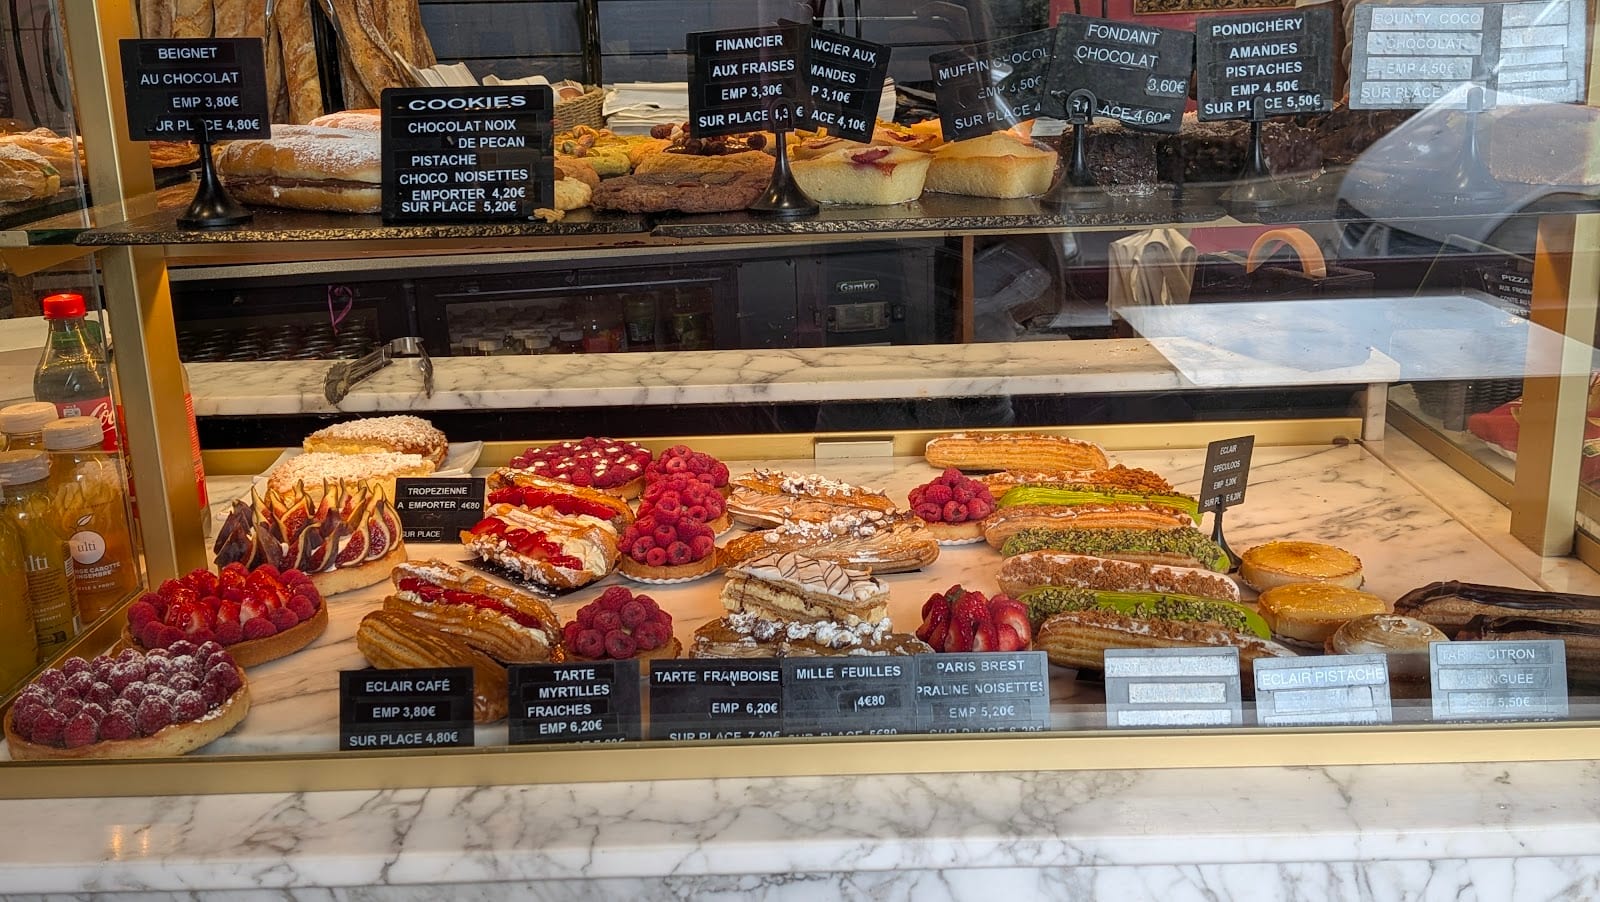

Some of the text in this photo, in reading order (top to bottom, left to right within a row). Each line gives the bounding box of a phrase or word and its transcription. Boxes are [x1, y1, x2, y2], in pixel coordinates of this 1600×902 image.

[1374, 13, 1481, 25] BOUNTY COCO
[1087, 23, 1160, 45] FONDANT
[715, 34, 784, 52] FINANCIER
[1229, 42, 1298, 59] AMANDES
[1386, 38, 1465, 50] CHOCOLAT
[157, 47, 218, 60] BEIGNET
[851, 48, 877, 64] AUX
[1076, 45, 1159, 68] CHOCOLAT
[712, 59, 795, 78] AUX FRAISES
[938, 59, 990, 81] MUFFIN
[1226, 61, 1303, 78] PISTACHES
[1386, 62, 1456, 75] EMP 4,50€
[140, 71, 240, 86] AU CHOCOLAT
[1146, 78, 1186, 94] 3,60€
[721, 83, 783, 101] EMP 3,30€
[820, 85, 851, 104] 3,10€
[1231, 83, 1260, 97] EMP
[1360, 87, 1391, 99] SUR
[1395, 87, 1441, 98] PLACE
[172, 95, 240, 110] EMP 3,80€
[408, 95, 527, 111] COOKIES
[1204, 94, 1321, 115] SUR PLCE 5,50€
[698, 105, 804, 128] SUR PLACE 4,3€
[836, 115, 867, 133] 4,10€
[955, 114, 984, 130] SUR
[986, 103, 1031, 123] PLACE
[177, 119, 224, 131] PLCE
[226, 118, 261, 132] 4,80€
[407, 118, 517, 134] CHOCOLAT NOIX
[458, 135, 526, 149] DE PECAN
[411, 154, 478, 167] PISTACHE
[399, 168, 529, 186] CHOCO NOISETTES
[411, 186, 526, 201] EMPORTER 4,20€
[401, 200, 518, 214] SUR PLACE 5,20€
[840, 281, 876, 292] Gamko
[1501, 274, 1530, 285] PIZZA
[1213, 460, 1240, 472] SPECULOOS
[407, 486, 468, 496] TROPEZIENNE
[396, 501, 481, 510] A EMPORTER 4€80
[417, 530, 441, 538] PLACE
[77, 541, 97, 553] ulti
[1487, 648, 1536, 660] CITRON
[796, 665, 902, 680] MILLE FEUILLES
[937, 660, 1025, 673] PARIS BREST
[553, 668, 596, 681] TARTE
[655, 670, 779, 682] TARTE FRAMBOISE
[1262, 667, 1385, 686] ECLAIR PISTACHE
[365, 678, 451, 693] ECLAIR CAFÉ
[539, 684, 610, 699] MYRTILLES
[917, 681, 1044, 697] PRALINE NOISETTES
[711, 702, 779, 716] EMP 6,20€
[1498, 696, 1531, 709] 5,50€
[372, 705, 437, 719] EMP 3,80€
[527, 703, 592, 718] FRAICHES
[949, 705, 1016, 719] EMP 5,20€
[539, 719, 604, 735] EMP 6,20€
[349, 731, 459, 747] SUR PLACE 4,80€
